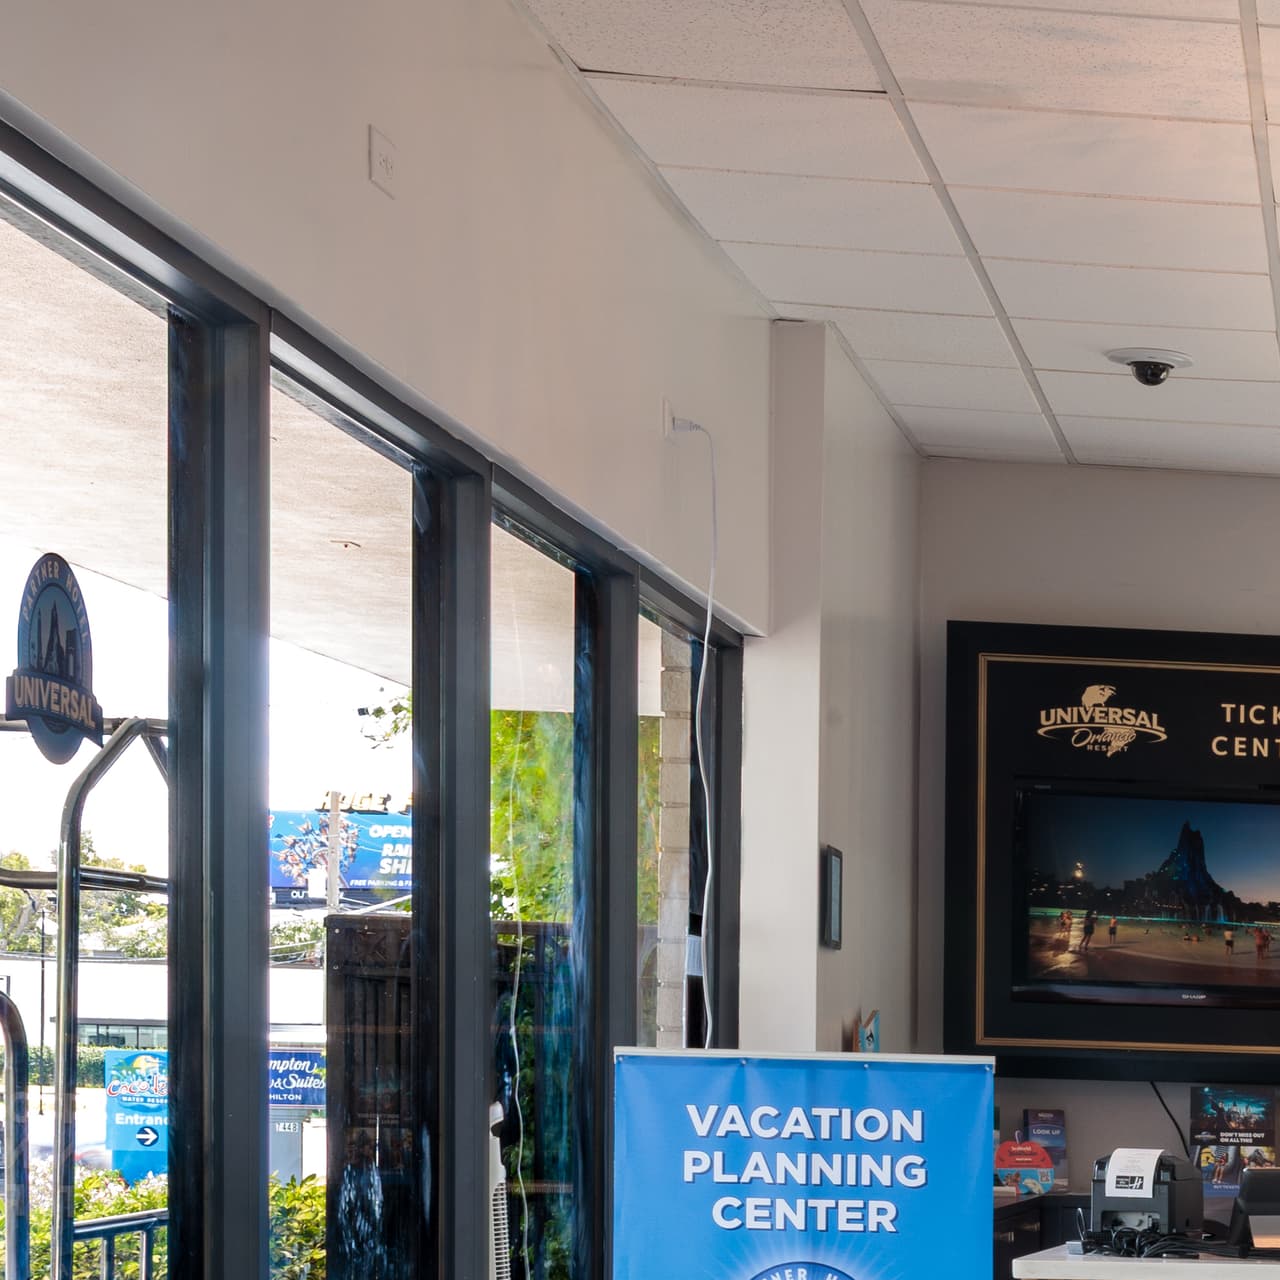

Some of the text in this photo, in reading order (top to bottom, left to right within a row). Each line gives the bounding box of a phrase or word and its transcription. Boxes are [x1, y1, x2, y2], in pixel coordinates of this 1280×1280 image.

[22, 560, 89, 640] PARTNER HOTEL
[14, 675, 96, 729] UNIVERSAL
[1040, 706, 1166, 732] UNIVERSAL
[1072, 728, 1136, 747] Orlando
[379, 858, 412, 874] SHI
[269, 1057, 317, 1073] mpton
[121, 1096, 144, 1104] WATER
[686, 1104, 925, 1143] VACATION
[683, 1150, 928, 1188] PLANNING
[712, 1196, 899, 1233] CENTER
